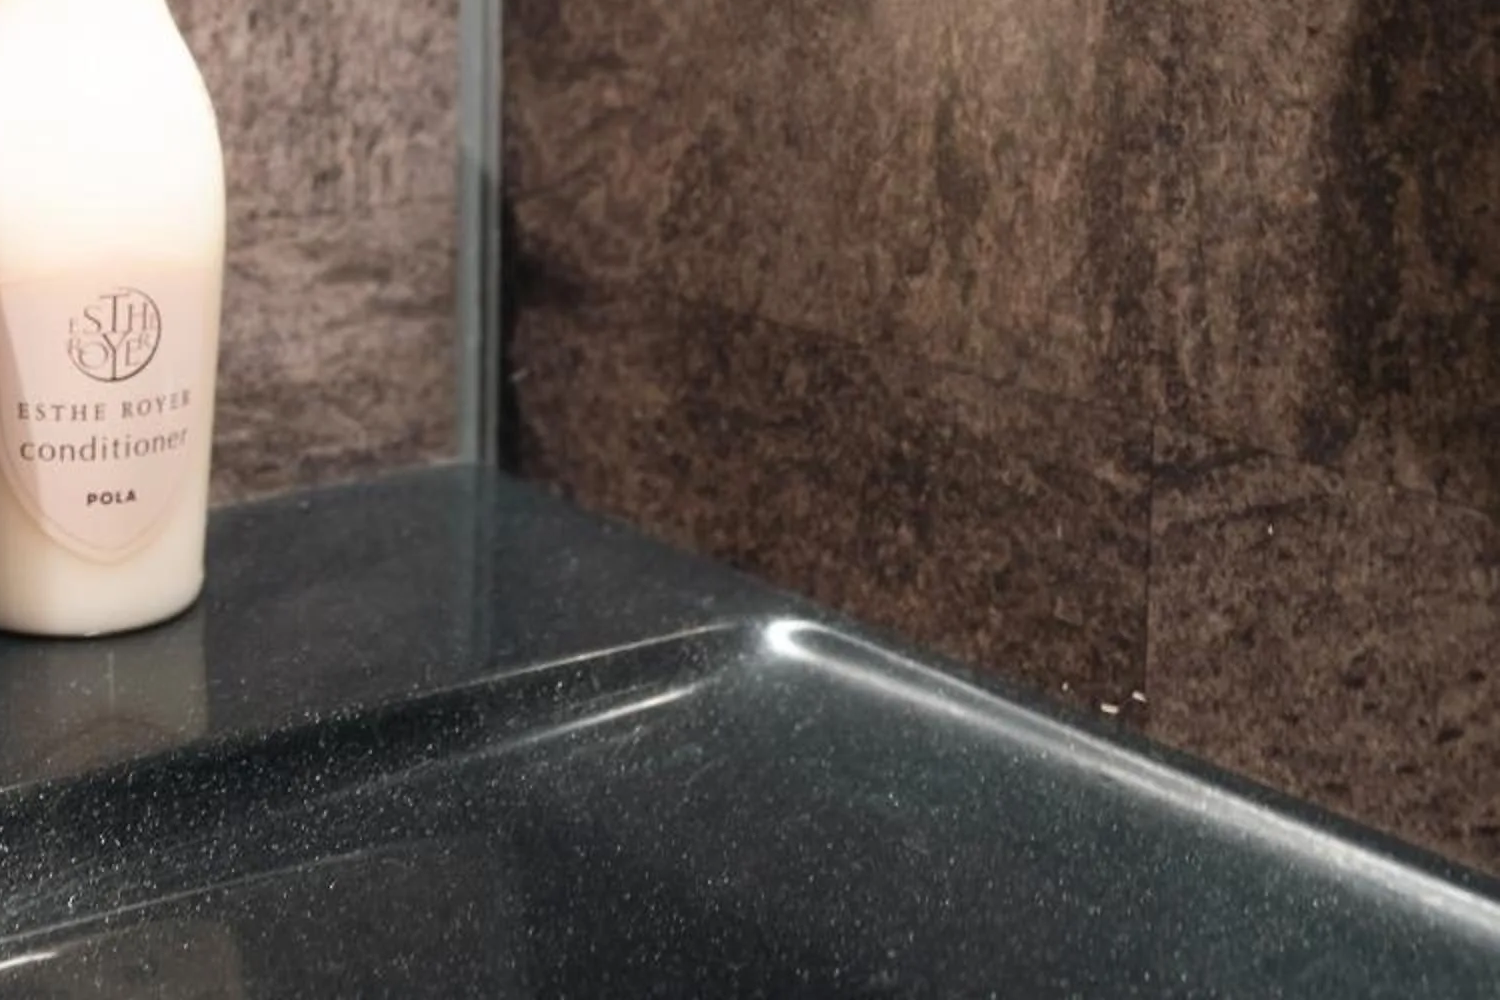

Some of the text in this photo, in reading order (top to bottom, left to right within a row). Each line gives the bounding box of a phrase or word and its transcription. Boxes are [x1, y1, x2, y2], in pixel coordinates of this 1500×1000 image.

[16, 389, 192, 423] ESTHE ROYER
[18, 428, 189, 464] conditioner
[85, 489, 138, 507] POLA
